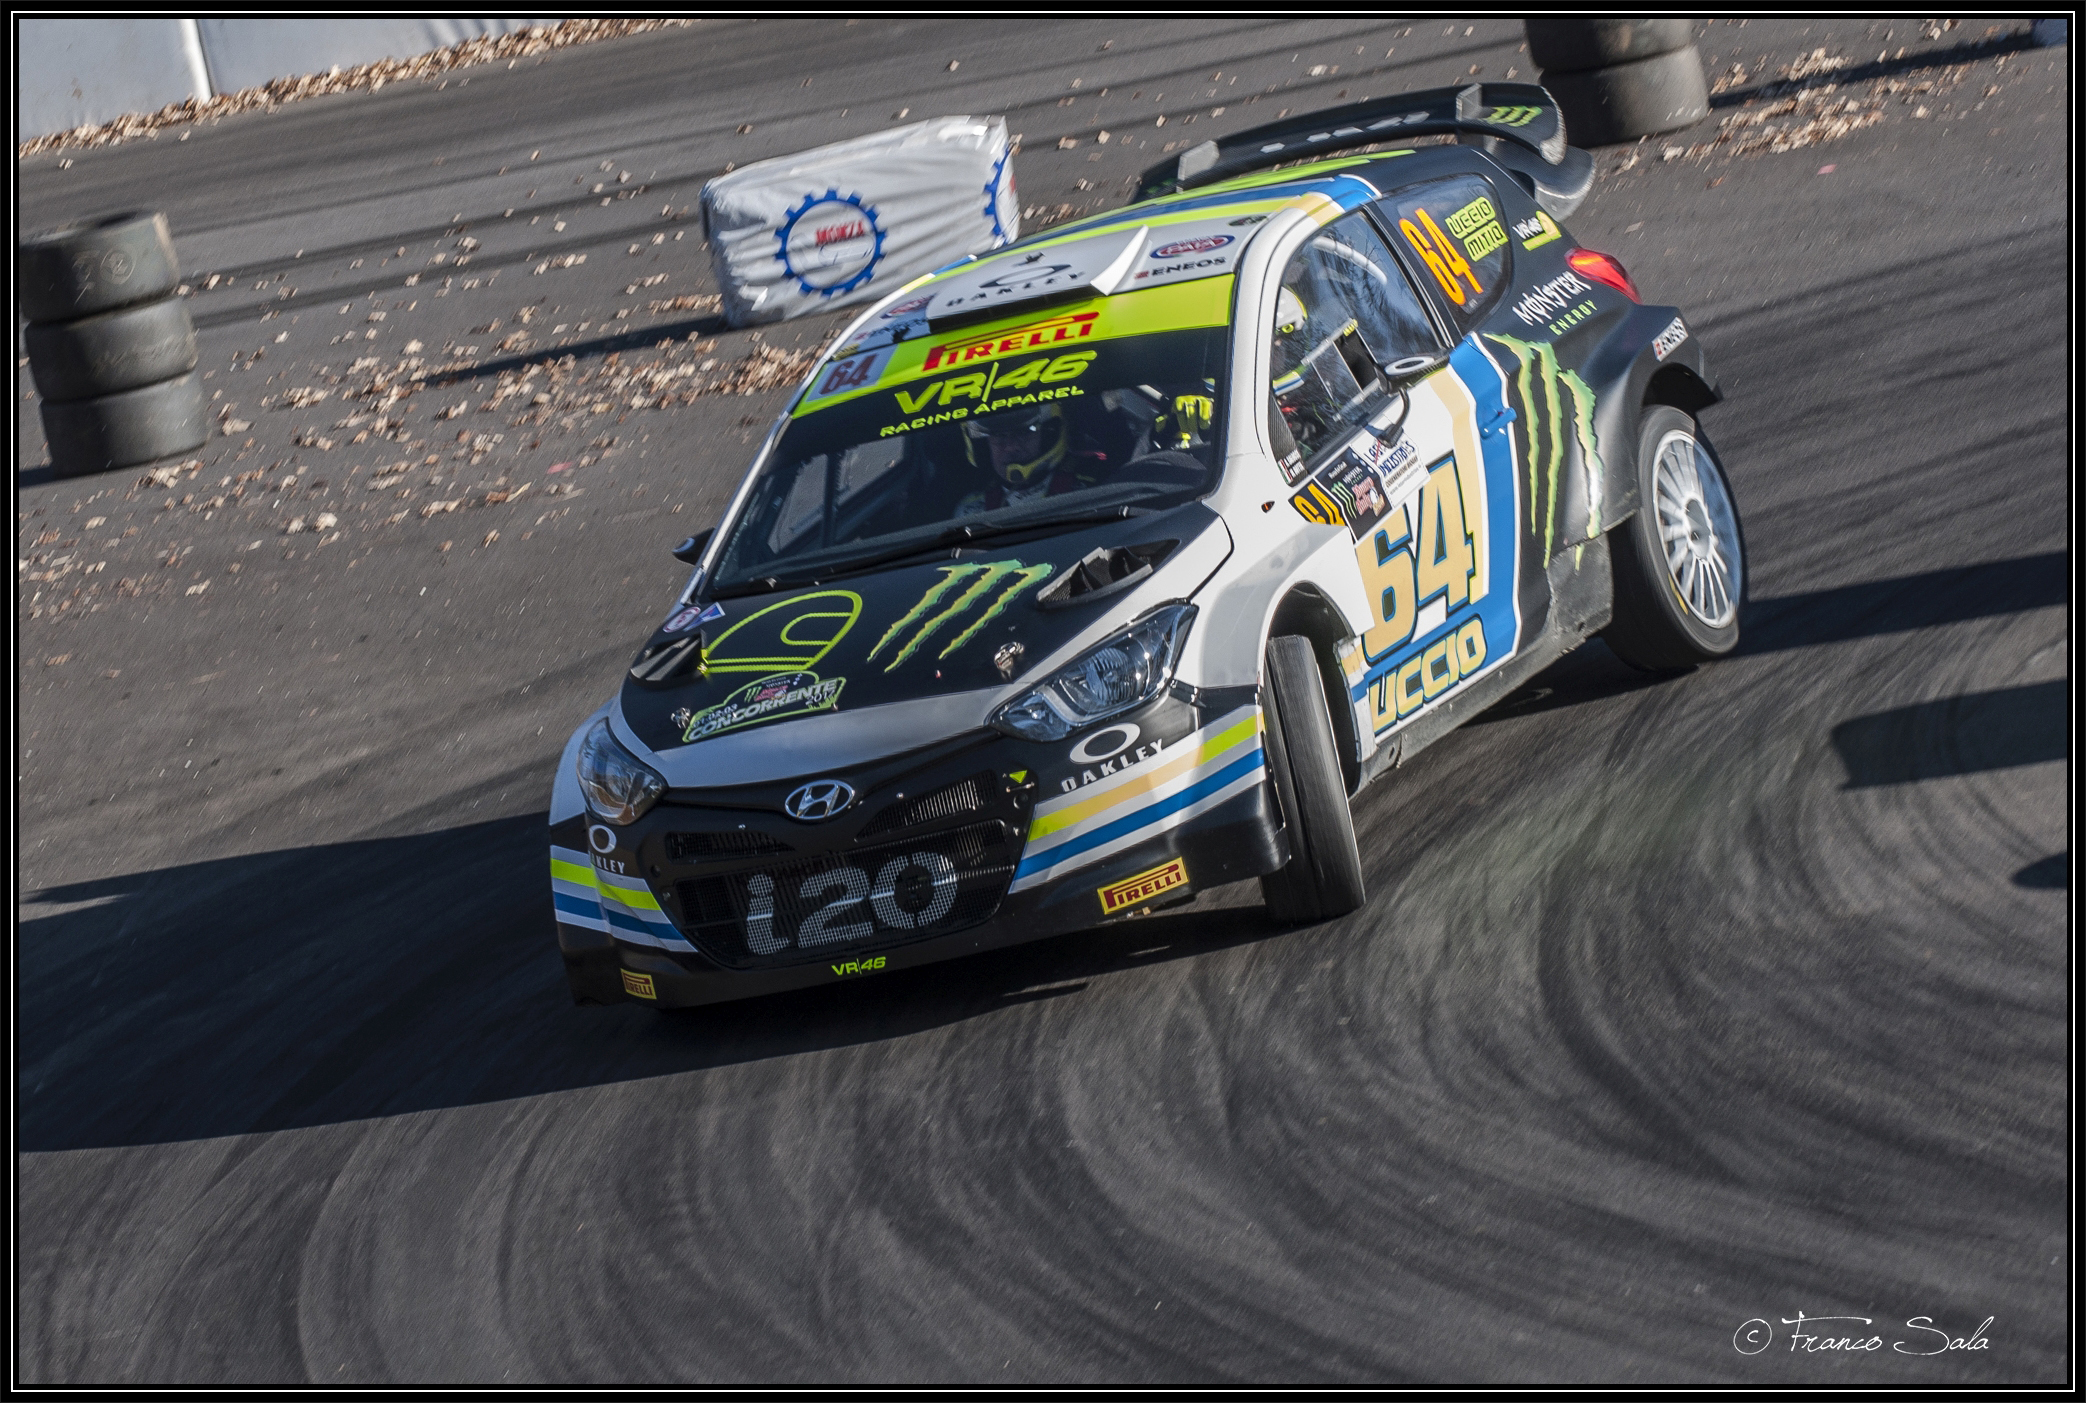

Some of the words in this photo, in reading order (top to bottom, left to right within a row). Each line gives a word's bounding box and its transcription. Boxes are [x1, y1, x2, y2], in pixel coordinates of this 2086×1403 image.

[1447, 197, 1495, 238] UCCIO
[1151, 256, 1228, 277] ENEOS
[1398, 207, 1484, 306] 64
[1512, 271, 1592, 327] MONSTER
[1549, 299, 1598, 336] ENERGY
[922, 312, 1101, 373] PIRELLI
[819, 353, 878, 395] 64
[880, 408, 969, 438] RACING
[974, 385, 1085, 415] APPAREL
[1294, 483, 1347, 527] 64
[1356, 450, 1476, 667] 64
[1367, 613, 1487, 735] UCCIO
[688, 678, 839, 742] CONCORRENTE
[1061, 738, 1164, 792] OAKLEY
[588, 851, 625, 875] AKLEY
[1103, 863, 1182, 909] PIRELLI
